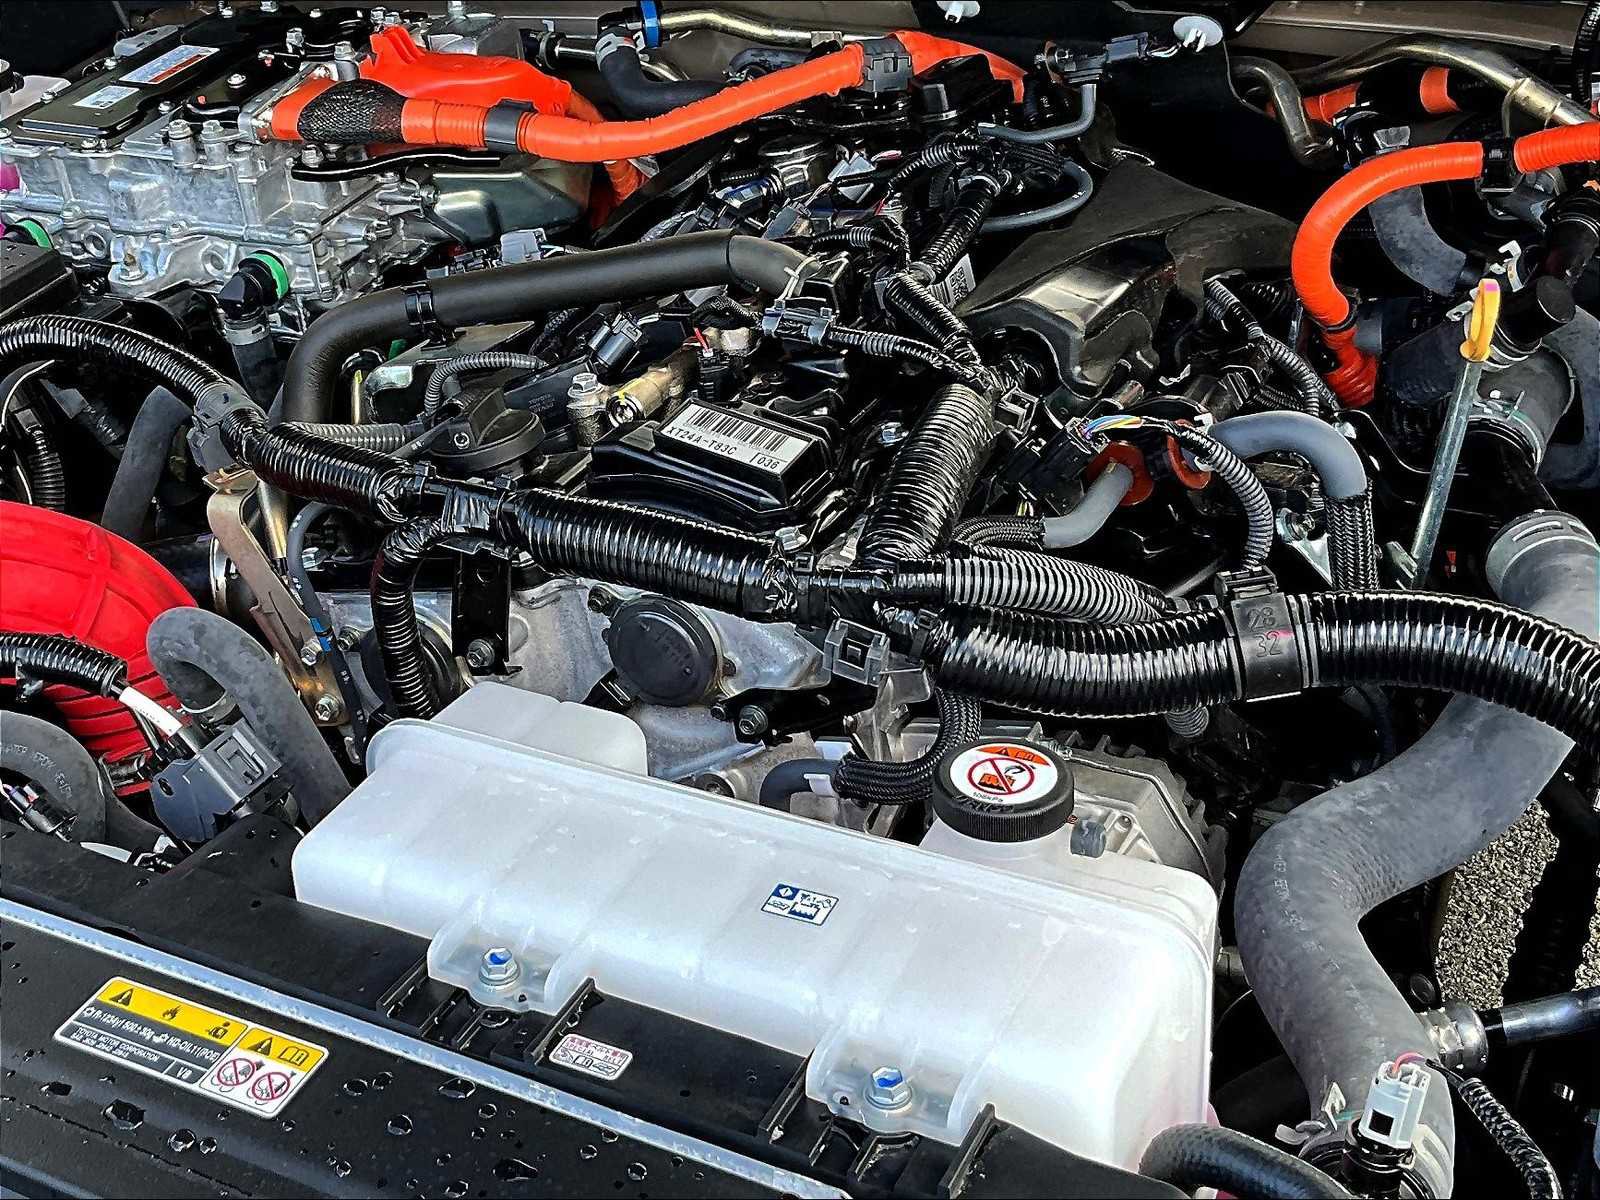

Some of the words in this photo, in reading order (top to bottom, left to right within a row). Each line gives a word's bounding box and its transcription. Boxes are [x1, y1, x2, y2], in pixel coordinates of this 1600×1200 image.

[666, 425, 738, 456] XT24A-T83C
[756, 457, 780, 470] 036
[1247, 606, 1276, 632] 28
[1254, 630, 1282, 658] 32
[91, 1009, 126, 1029] R-1234yf
[75, 1027, 99, 1040] TOYOTA
[98, 1034, 120, 1047] MOTOR
[119, 1041, 161, 1062] CORPORATION
[564, 1042, 594, 1056] SPECIAL
